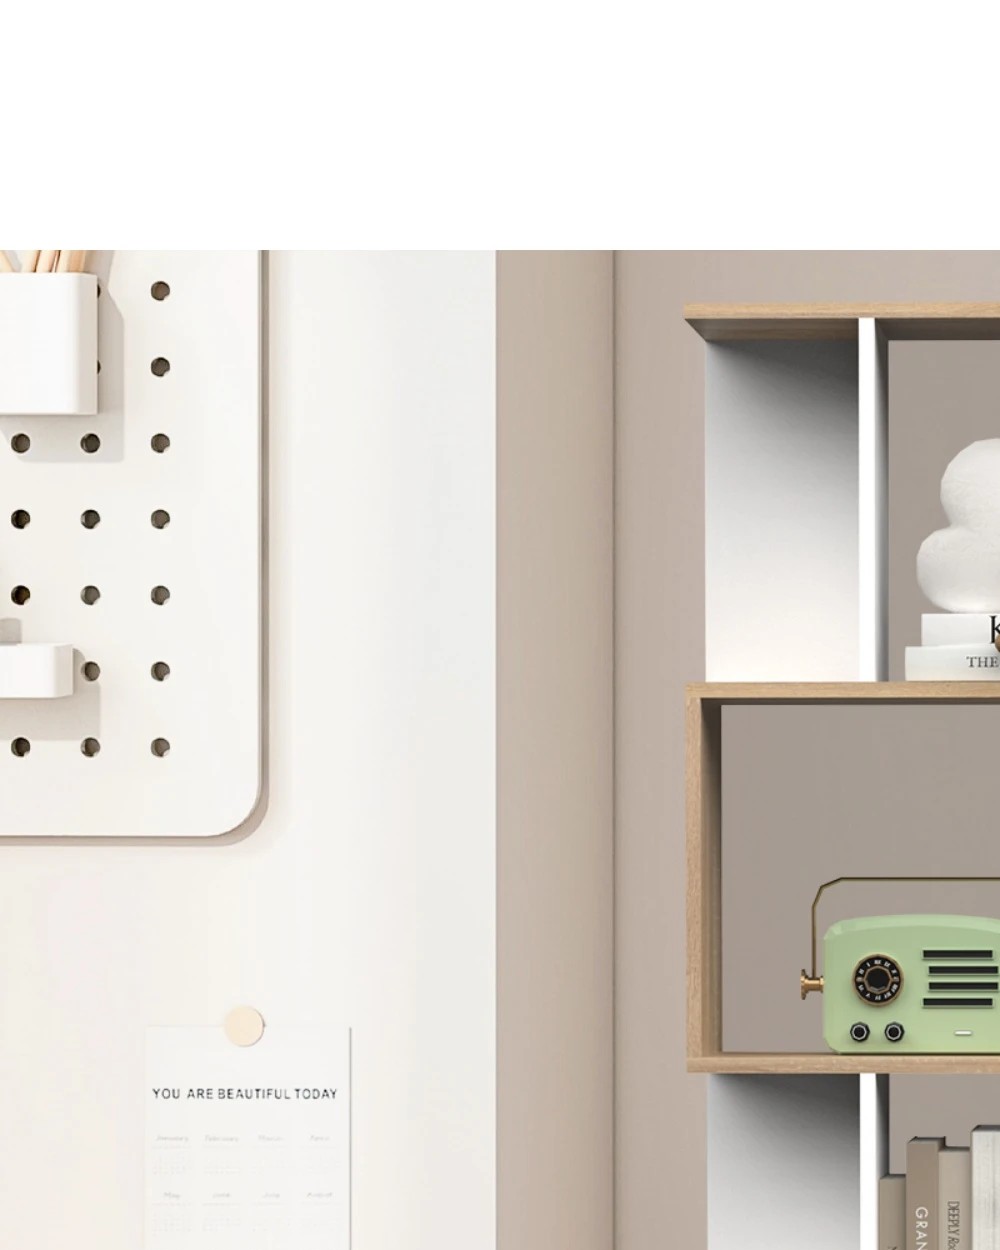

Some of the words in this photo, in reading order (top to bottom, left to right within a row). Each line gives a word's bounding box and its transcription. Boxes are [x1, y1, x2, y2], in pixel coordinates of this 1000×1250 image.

[966, 655, 999, 669] THE
[152, 1088, 181, 1100] YOU
[187, 1088, 214, 1100] ARE
[217, 1088, 291, 1100] BEAUTIFUL
[294, 1088, 338, 1100] TODAY
[947, 1200, 961, 1238] DEEPLY
